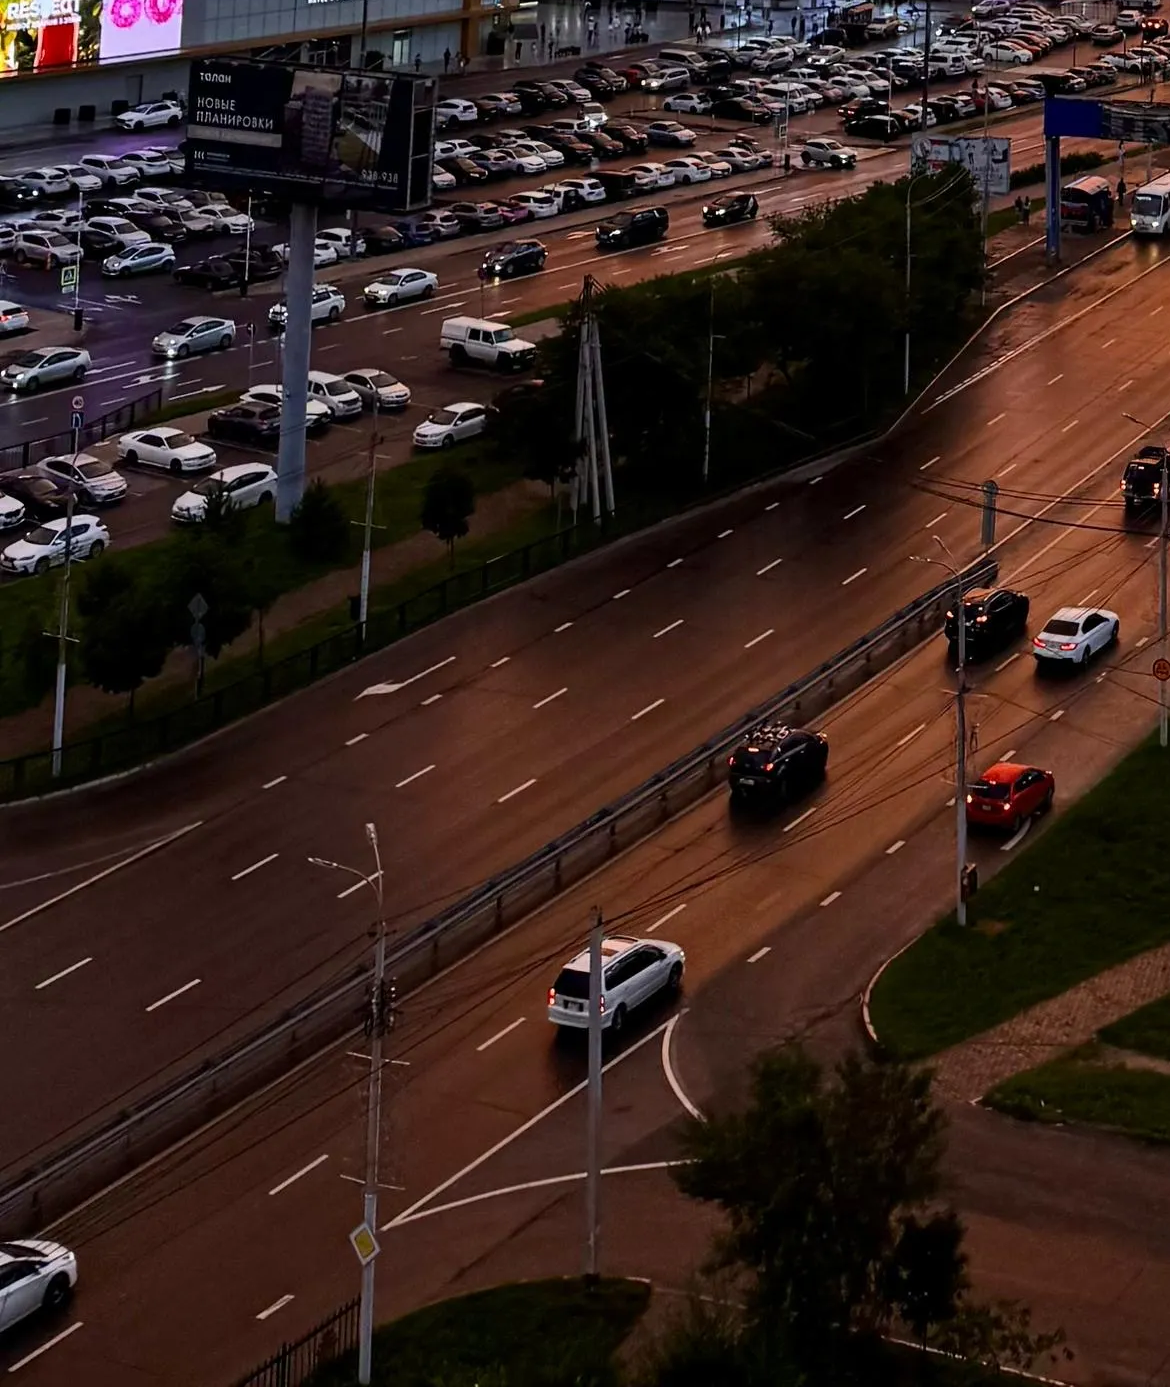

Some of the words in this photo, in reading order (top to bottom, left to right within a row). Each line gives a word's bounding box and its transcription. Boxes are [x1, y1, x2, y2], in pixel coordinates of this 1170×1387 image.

[200, 72, 232, 84] талан
[197, 96, 237, 111] НОВЫЕ
[196, 110, 274, 130] ПЛАНИРОВКИ
